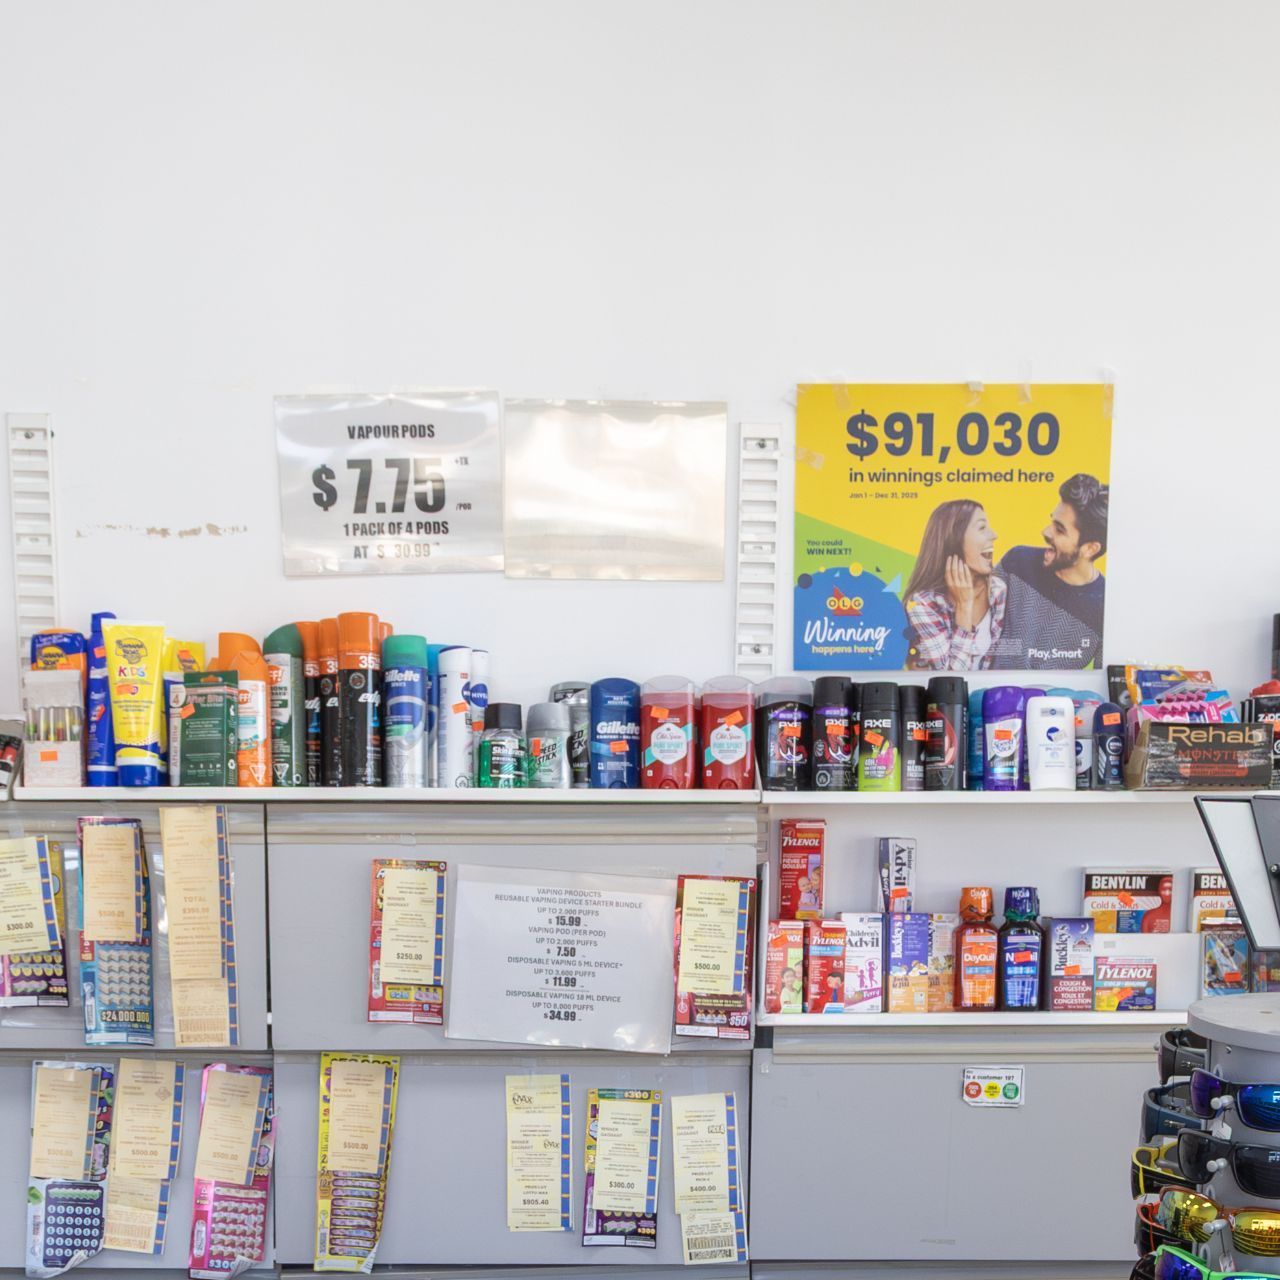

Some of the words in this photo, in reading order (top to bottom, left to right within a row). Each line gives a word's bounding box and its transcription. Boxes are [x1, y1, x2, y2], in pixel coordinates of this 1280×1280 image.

[348, 425, 399, 439] VAPOUR
[402, 424, 435, 438] PODS
[846, 409, 1060, 464] $91,030
[849, 468, 863, 483] in
[868, 469, 942, 487] winnings
[947, 468, 1014, 483] claimed
[1018, 468, 1054, 482] here
[312, 464, 338, 512] $
[347, 458, 446, 514] 7.75
[344, 524, 349, 536] 1
[353, 522, 384, 536] PACK
[388, 522, 403, 535] OF
[405, 522, 413, 534] 4
[416, 521, 449, 534] PODS
[826, 548, 852, 556] NEXT!
[812, 645, 850, 654] happens
[853, 645, 875, 653] here
[597, 722, 639, 733] Gillette
[864, 719, 891, 727] AXE
[1169, 726, 1263, 746] Rehab
[783, 837, 819, 846] TYLENOL
[1092, 876, 1146, 889] BENYLIN
[537, 888, 562, 896] VAPING
[565, 890, 601, 898] PRODUCTS
[615, 901, 642, 909] BUNDLE
[556, 916, 581, 926] 15.99
[6, 922, 34, 931] $300.00
[846, 938, 879, 947] Advil
[557, 947, 576, 957] 7.50
[963, 953, 995, 962] DayQuil
[694, 963, 720, 971] $500.00
[1098, 965, 1152, 979] TYLENOL
[553, 977, 576, 987] 11.99
[550, 1010, 576, 1021] 34.99
